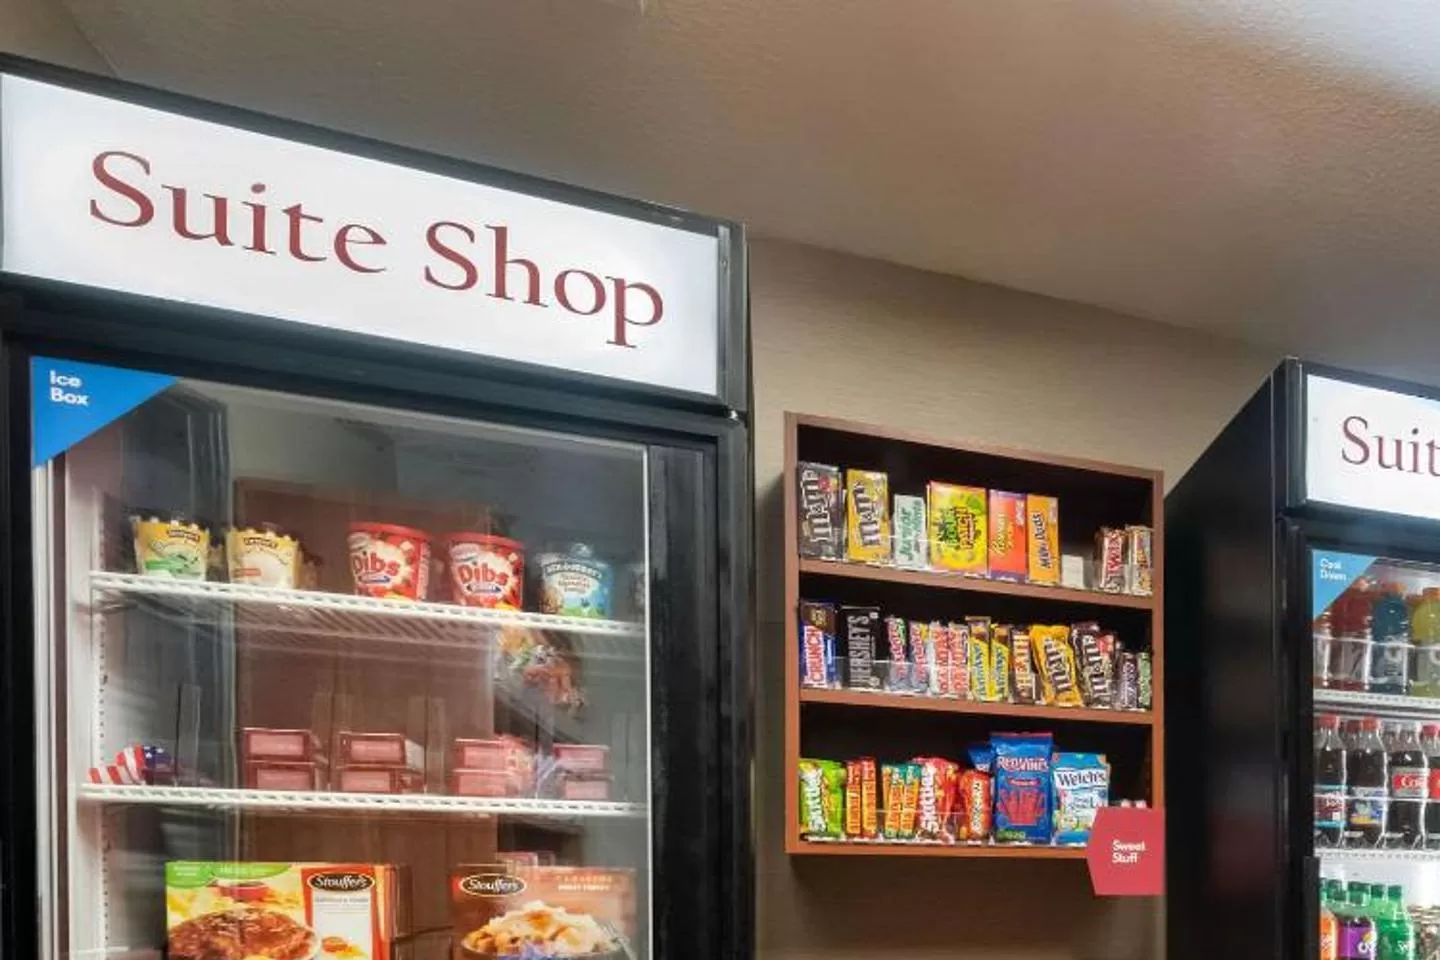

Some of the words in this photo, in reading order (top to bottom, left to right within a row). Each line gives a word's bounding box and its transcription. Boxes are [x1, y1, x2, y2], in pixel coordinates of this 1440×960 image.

[90, 151, 388, 274] Suite
[424, 221, 664, 348] Shop
[50, 369, 82, 389] Ice
[50, 387, 90, 407] Box
[352, 550, 401, 577] Dibs
[457, 562, 510, 587] Dibs
[1057, 771, 1108, 787] Welch's
[1112, 839, 1146, 852] Sweet
[1112, 851, 1139, 864] Stuff
[315, 874, 368, 890] Stouffer's
[467, 878, 520, 893] Stouffer's
